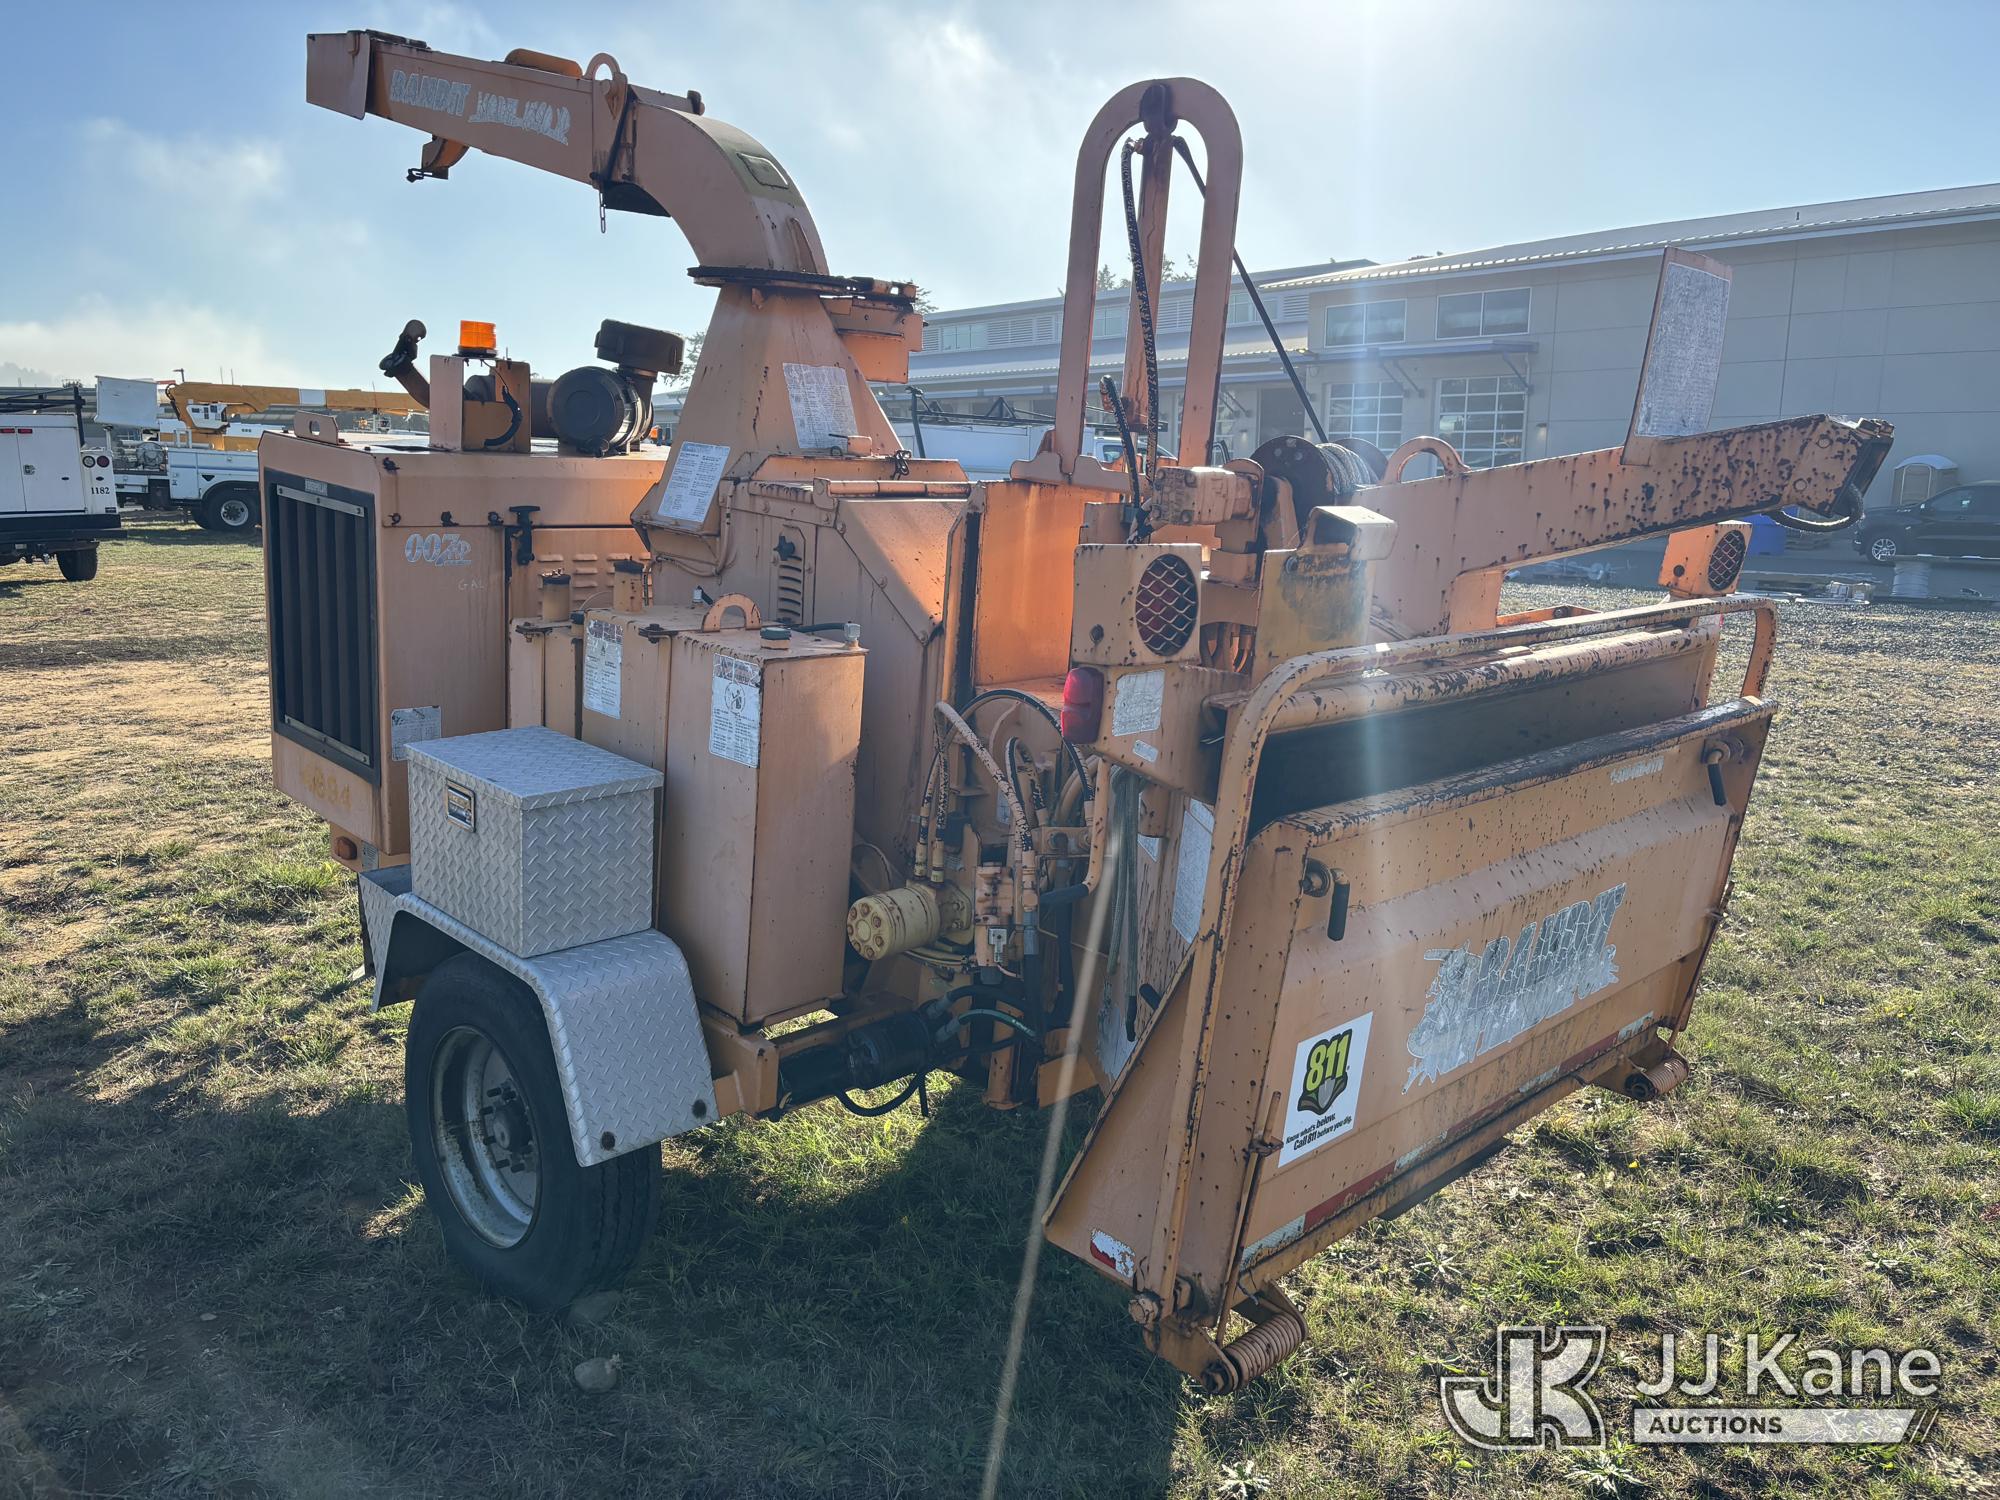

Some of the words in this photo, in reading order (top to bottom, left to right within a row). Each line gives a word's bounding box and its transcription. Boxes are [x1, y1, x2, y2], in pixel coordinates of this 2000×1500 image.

[91, 487, 110, 495] 1182
[1306, 1032, 1351, 1092] 811
[1286, 1133, 1300, 1144] Know
[1300, 1124, 1316, 1137] what's
[1294, 1135, 1308, 1150] Call
[1307, 1130, 1318, 1144] 811
[1317, 1126, 1334, 1139] before
[1333, 1120, 1344, 1132] you
